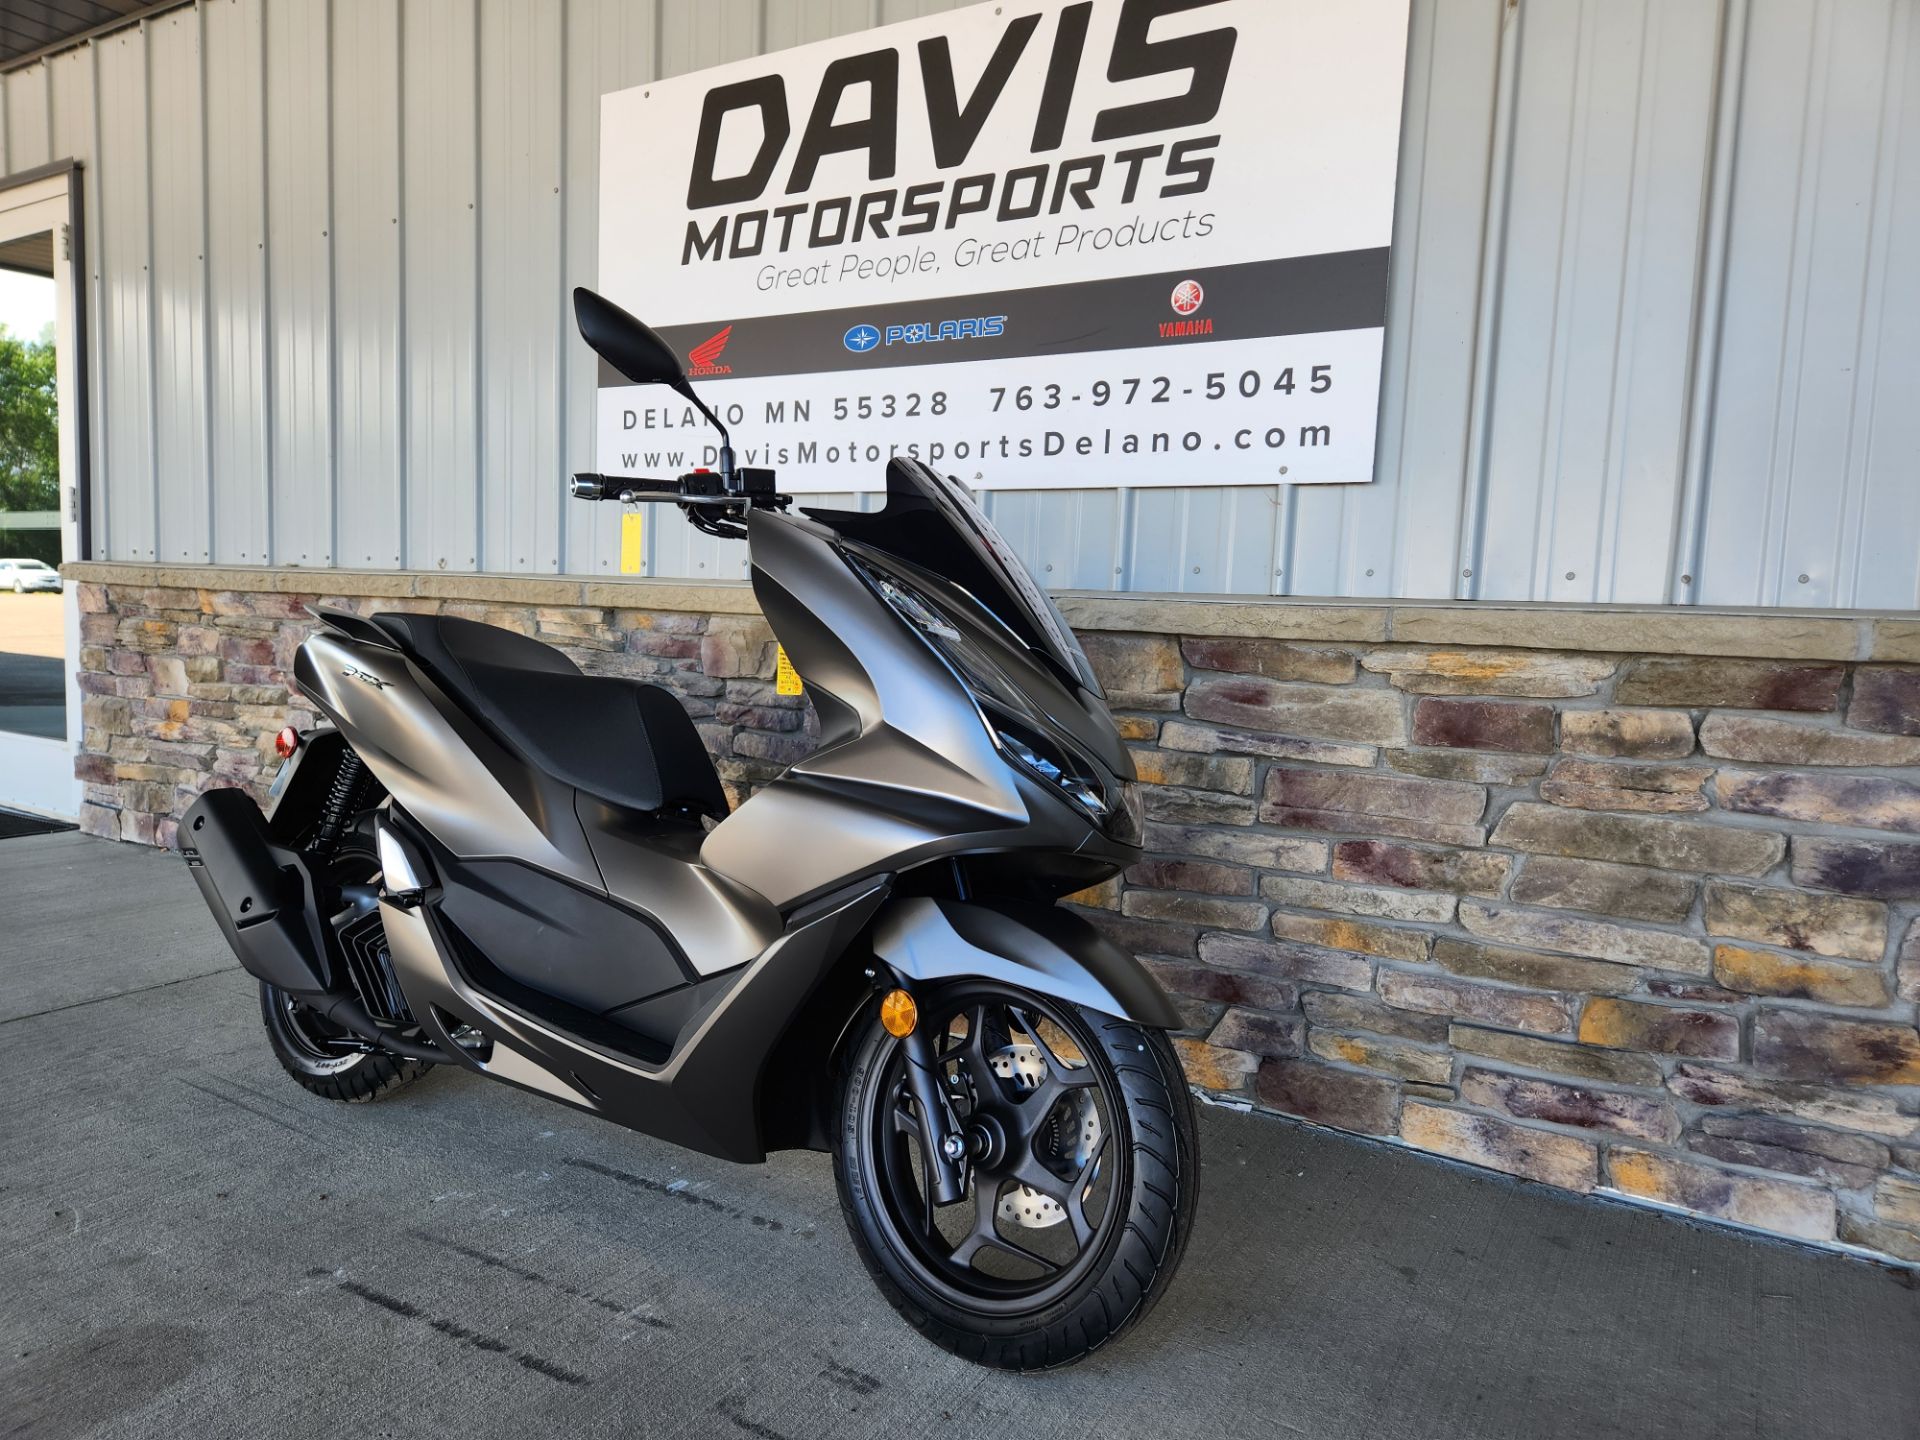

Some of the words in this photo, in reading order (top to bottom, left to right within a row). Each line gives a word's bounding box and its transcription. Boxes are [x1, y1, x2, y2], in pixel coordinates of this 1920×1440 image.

[685, 0, 1238, 210] DAVIS
[681, 134, 1220, 266] MOTORSPORTS
[756, 261, 830, 291] Great
[839, 246, 941, 284] People,
[953, 232, 1045, 270] Great
[1055, 210, 1215, 256] Products
[885, 315, 1005, 346] POLARIS
[1158, 318, 1213, 338] YAMAHA
[688, 366, 733, 376] HONDA
[765, 398, 811, 424] MN
[833, 390, 948, 420] 55328
[989, 364, 1333, 413] 763-972-5045
[621, 423, 1332, 468] www.DvisMotorsportsDelano.com
